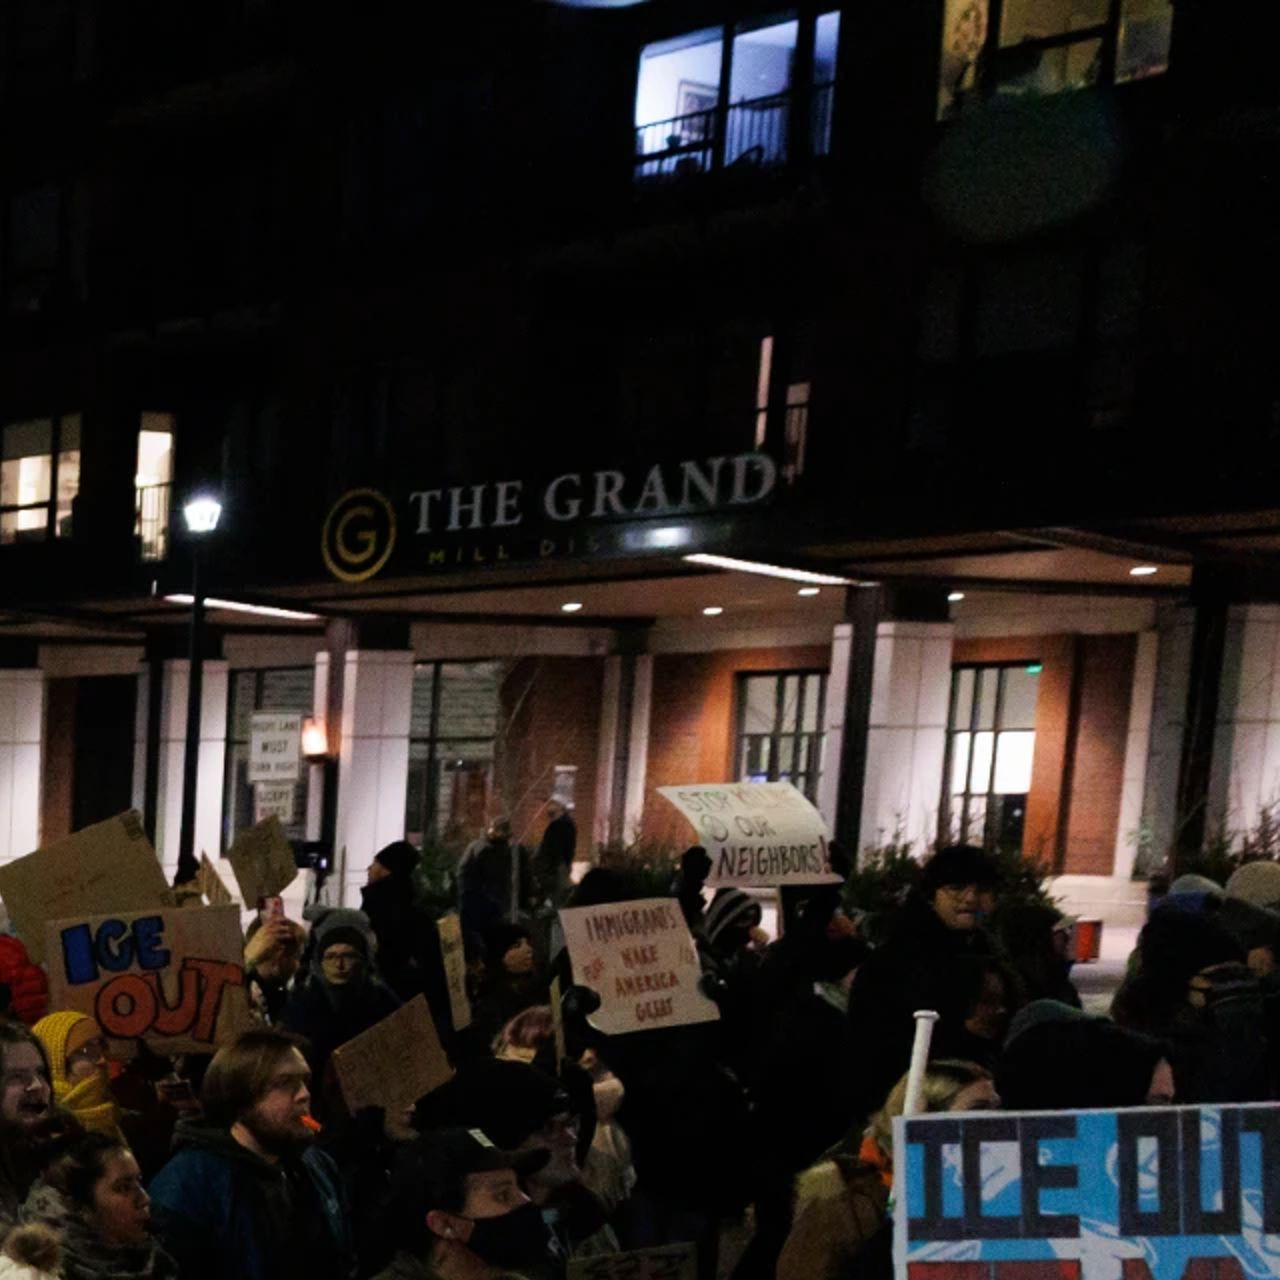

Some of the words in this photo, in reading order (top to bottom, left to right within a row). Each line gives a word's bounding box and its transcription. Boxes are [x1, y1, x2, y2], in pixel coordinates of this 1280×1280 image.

[408, 480, 525, 535] THE
[543, 452, 779, 521] GRAND
[425, 544, 511, 565] MILL
[717, 835, 833, 878] NEIGHBORS!
[61, 916, 171, 985] ICE
[585, 905, 676, 943] IMMIGRANTS
[95, 957, 245, 1043] OUT
[906, 1115, 1080, 1240] ICE
